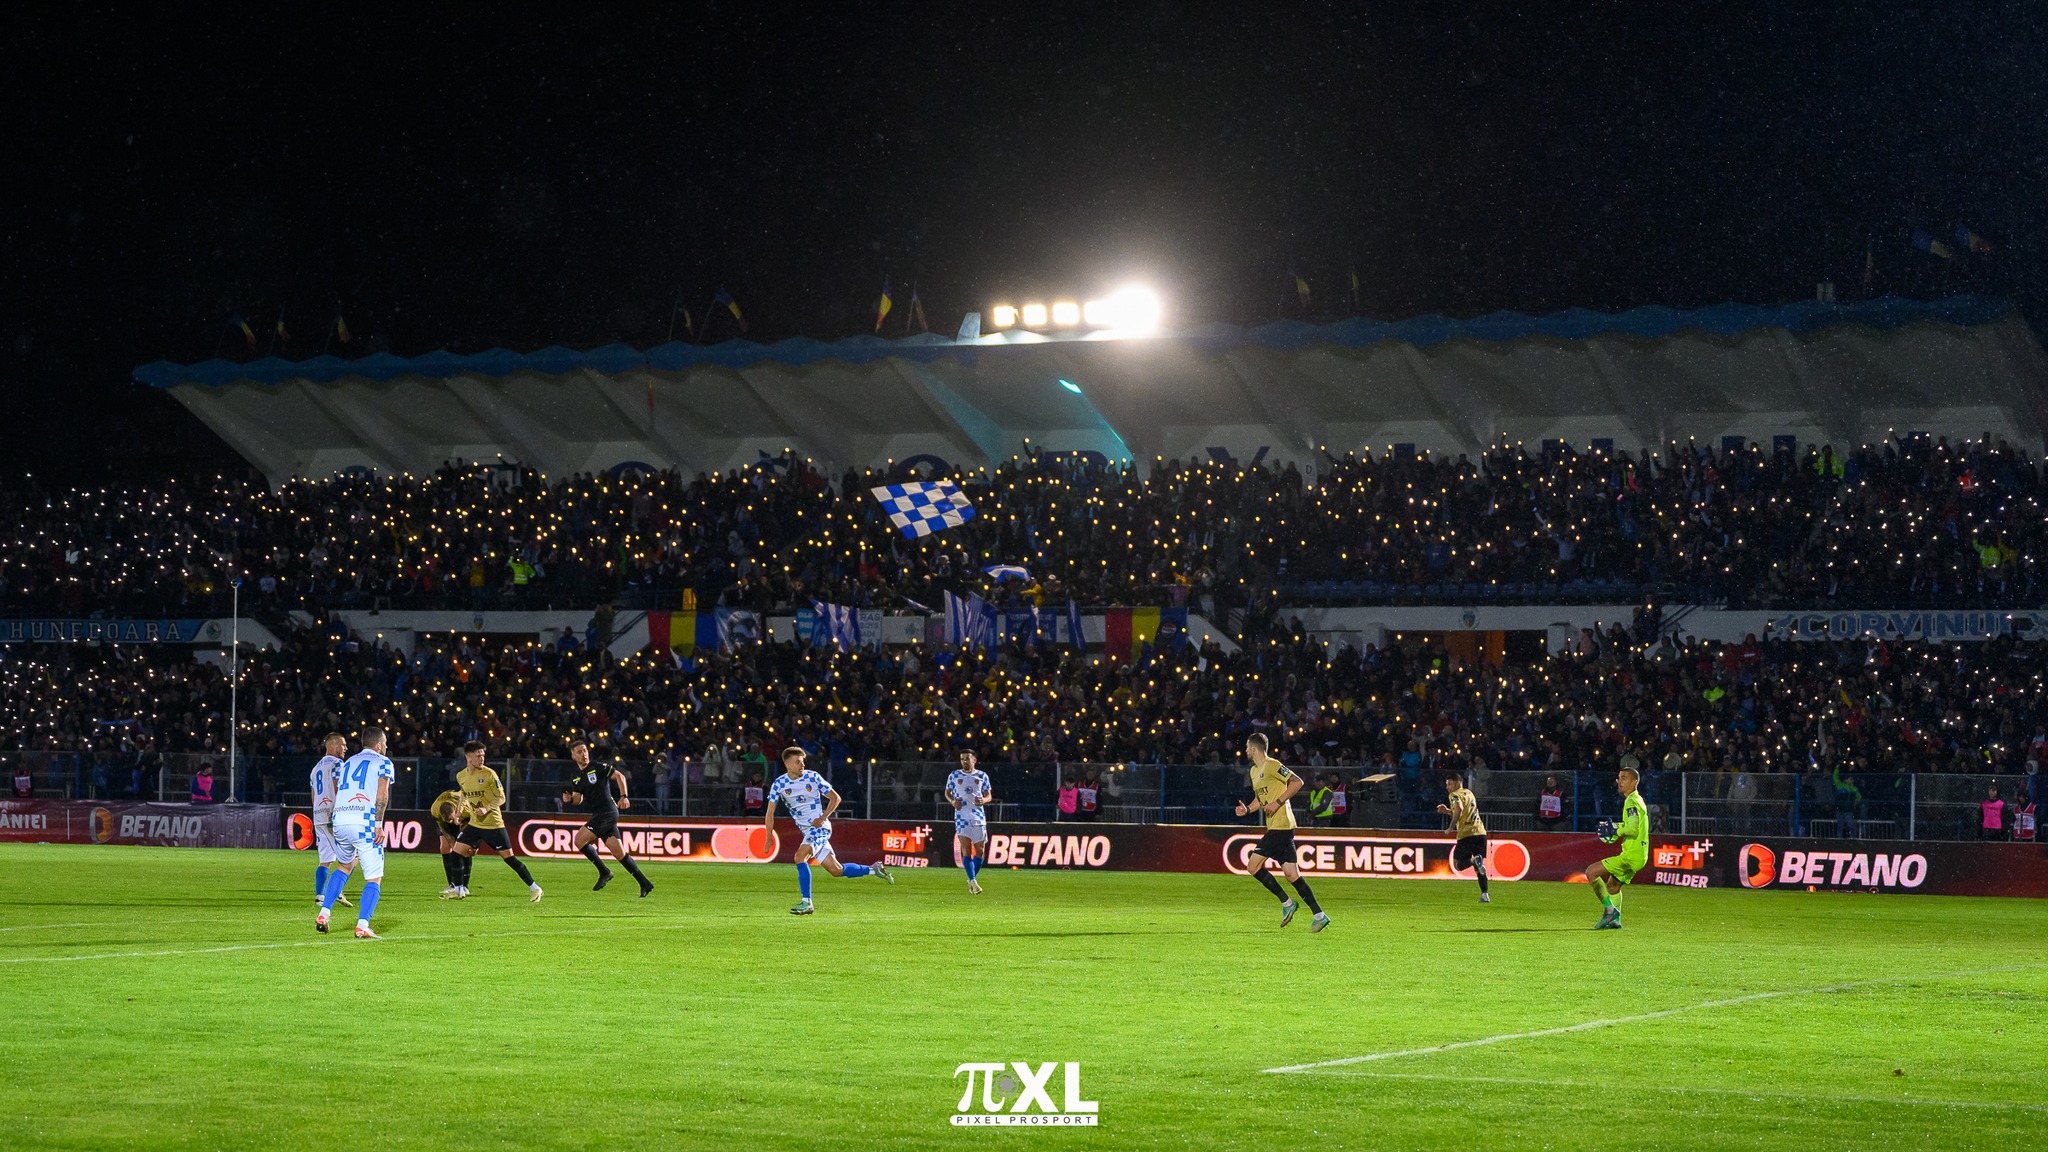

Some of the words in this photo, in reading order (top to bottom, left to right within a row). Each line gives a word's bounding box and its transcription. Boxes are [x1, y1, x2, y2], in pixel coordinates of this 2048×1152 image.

[10, 622, 181, 640] HUNEDOARA
[315, 770, 324, 795] 8
[339, 759, 371, 791] 14
[119, 814, 202, 839] BETANO
[621, 830, 691, 855] MECI
[886, 836, 907, 849] BET
[987, 834, 1111, 867] BETANO
[884, 854, 929, 868] BUILDER
[1344, 845, 1424, 872] MECI
[1657, 851, 1684, 866] BET
[1778, 850, 1928, 888] BETANO
[1655, 871, 1709, 888] BUILDER
